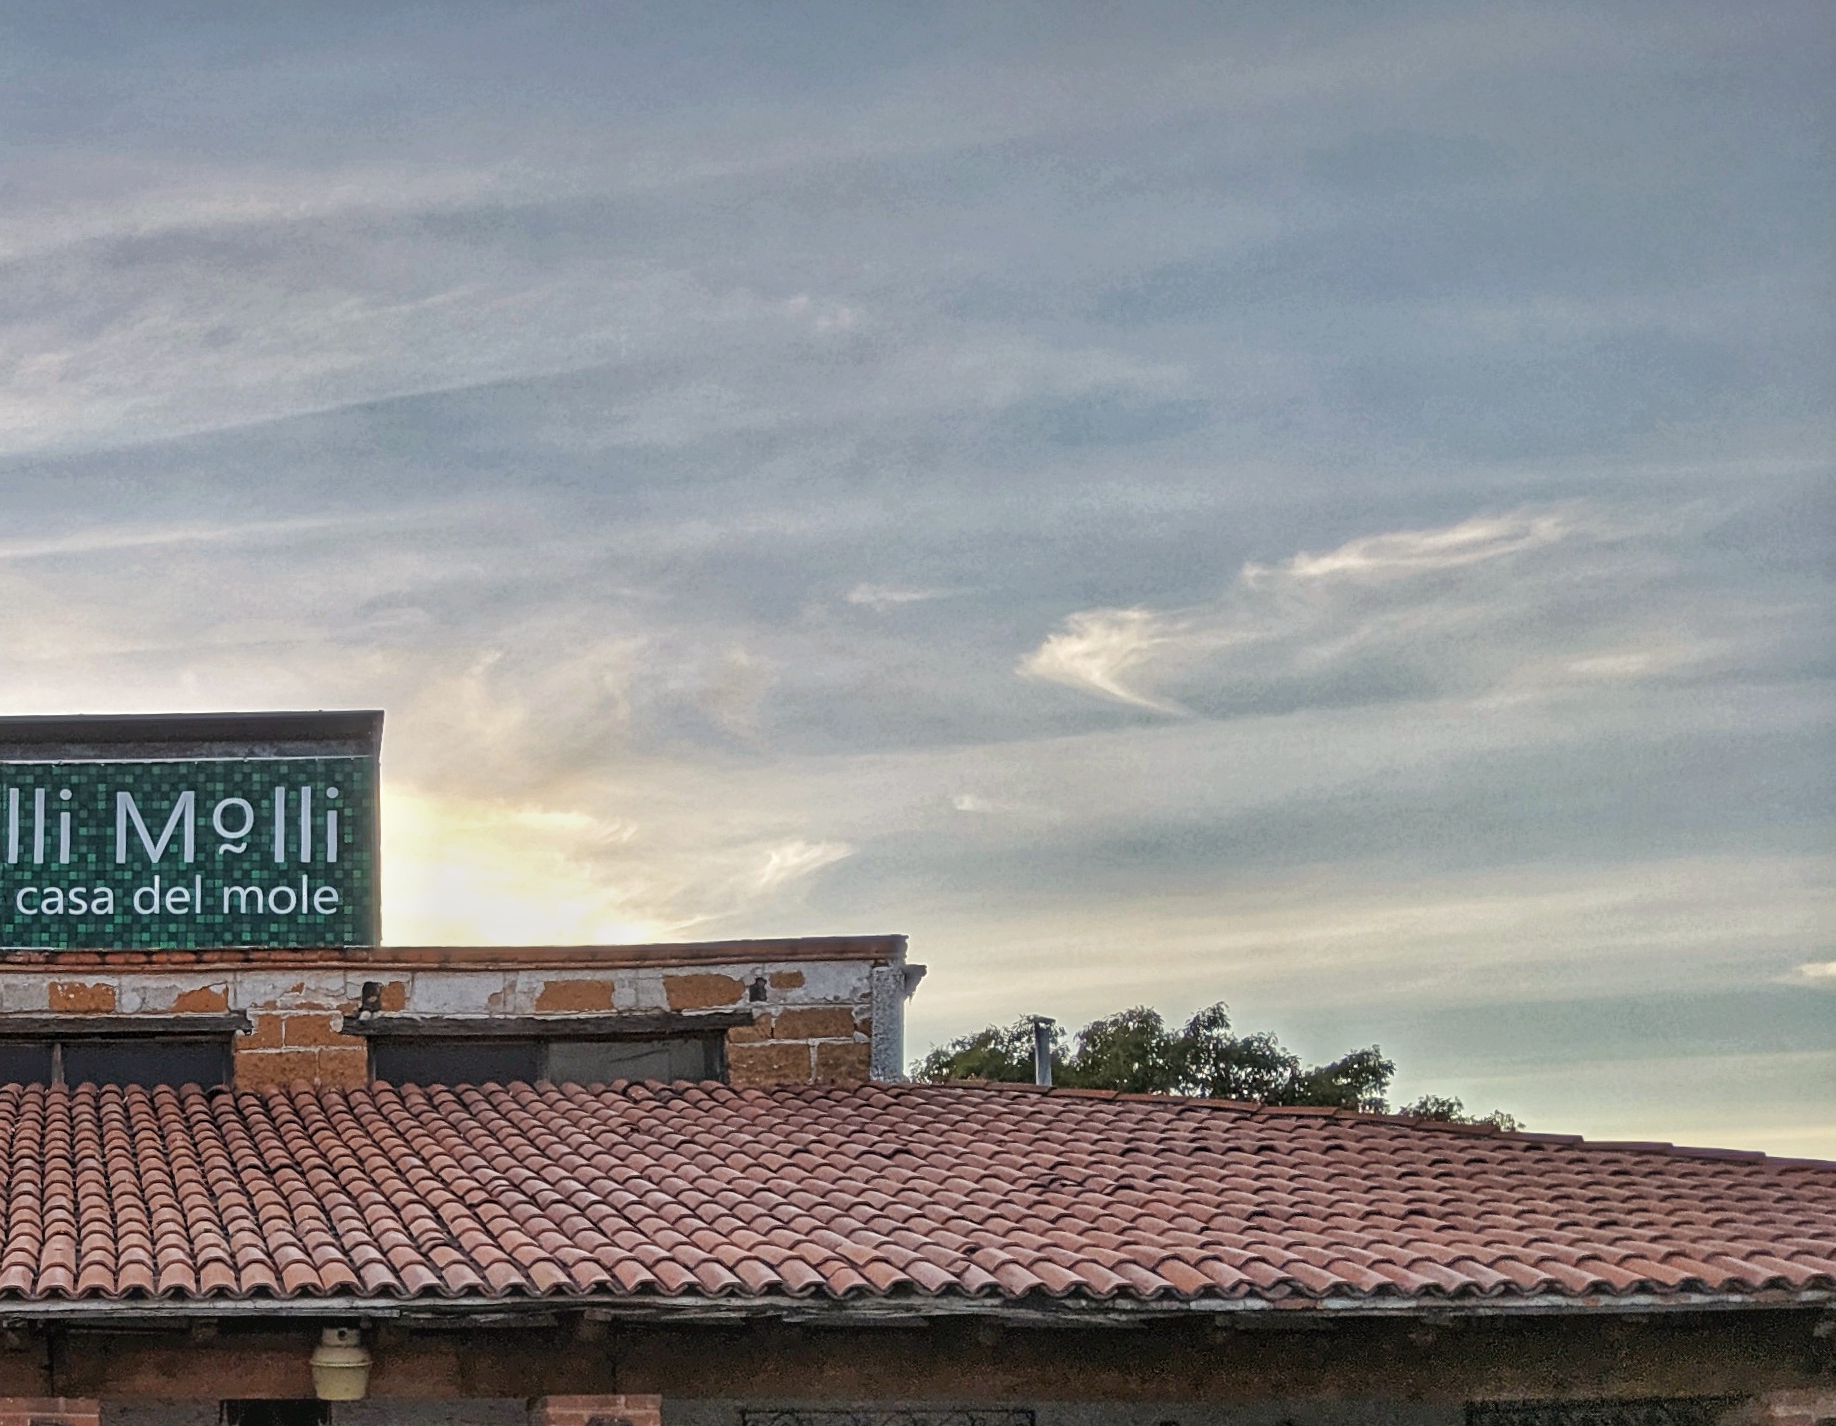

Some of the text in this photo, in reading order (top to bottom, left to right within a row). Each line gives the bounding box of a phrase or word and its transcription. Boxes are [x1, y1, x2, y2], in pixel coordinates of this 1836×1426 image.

[16, 885, 114, 916] casa
[132, 874, 202, 915] del
[223, 874, 339, 915] mole
